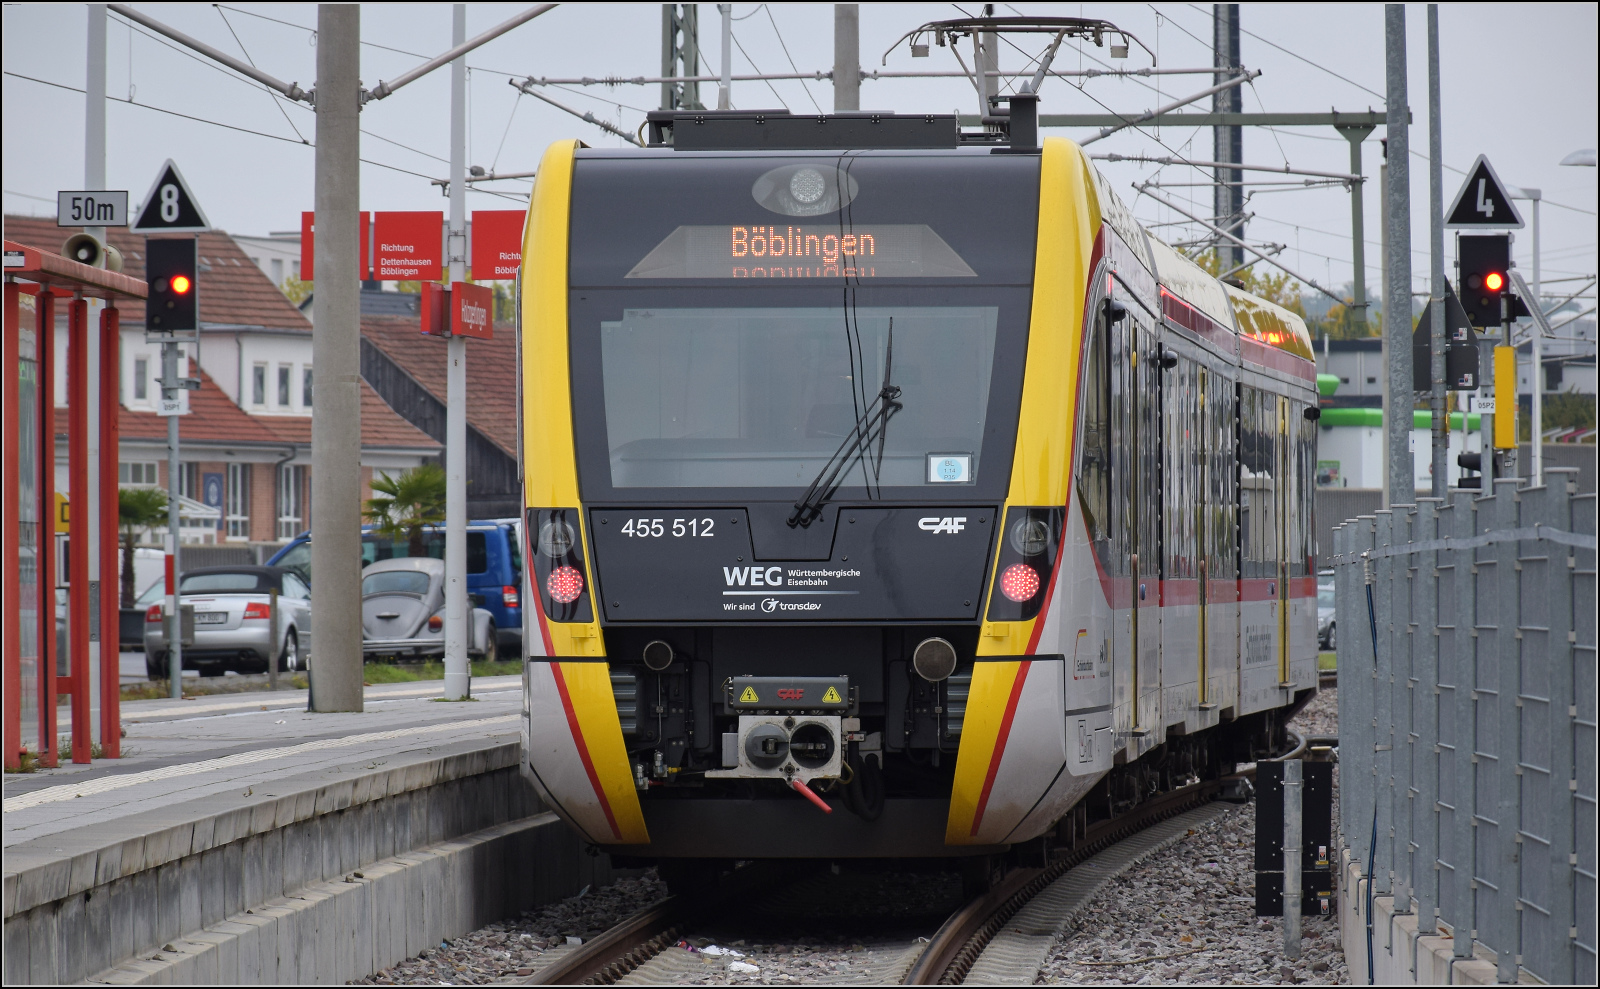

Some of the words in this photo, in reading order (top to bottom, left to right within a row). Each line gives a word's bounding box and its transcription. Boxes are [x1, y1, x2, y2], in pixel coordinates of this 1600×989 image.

[160, 183, 180, 223] 8
[1476, 178, 1495, 218] 4
[71, 196, 114, 221] 50m
[380, 243, 415, 253] Richtung
[732, 226, 875, 263] Böblingen
[380, 257, 432, 266] Dettenhausen
[380, 266, 419, 276] Böblingen
[620, 518, 665, 538] 455
[672, 518, 715, 538] 512
[917, 516, 967, 534] CAF
[723, 566, 783, 587] WEG
[787, 568, 861, 578] Württembergische
[787, 578, 829, 586] Eisenbahn
[723, 602, 738, 611] Wir
[738, 602, 756, 611] sind
[779, 601, 822, 611] transdev
[776, 688, 805, 701] CAF
